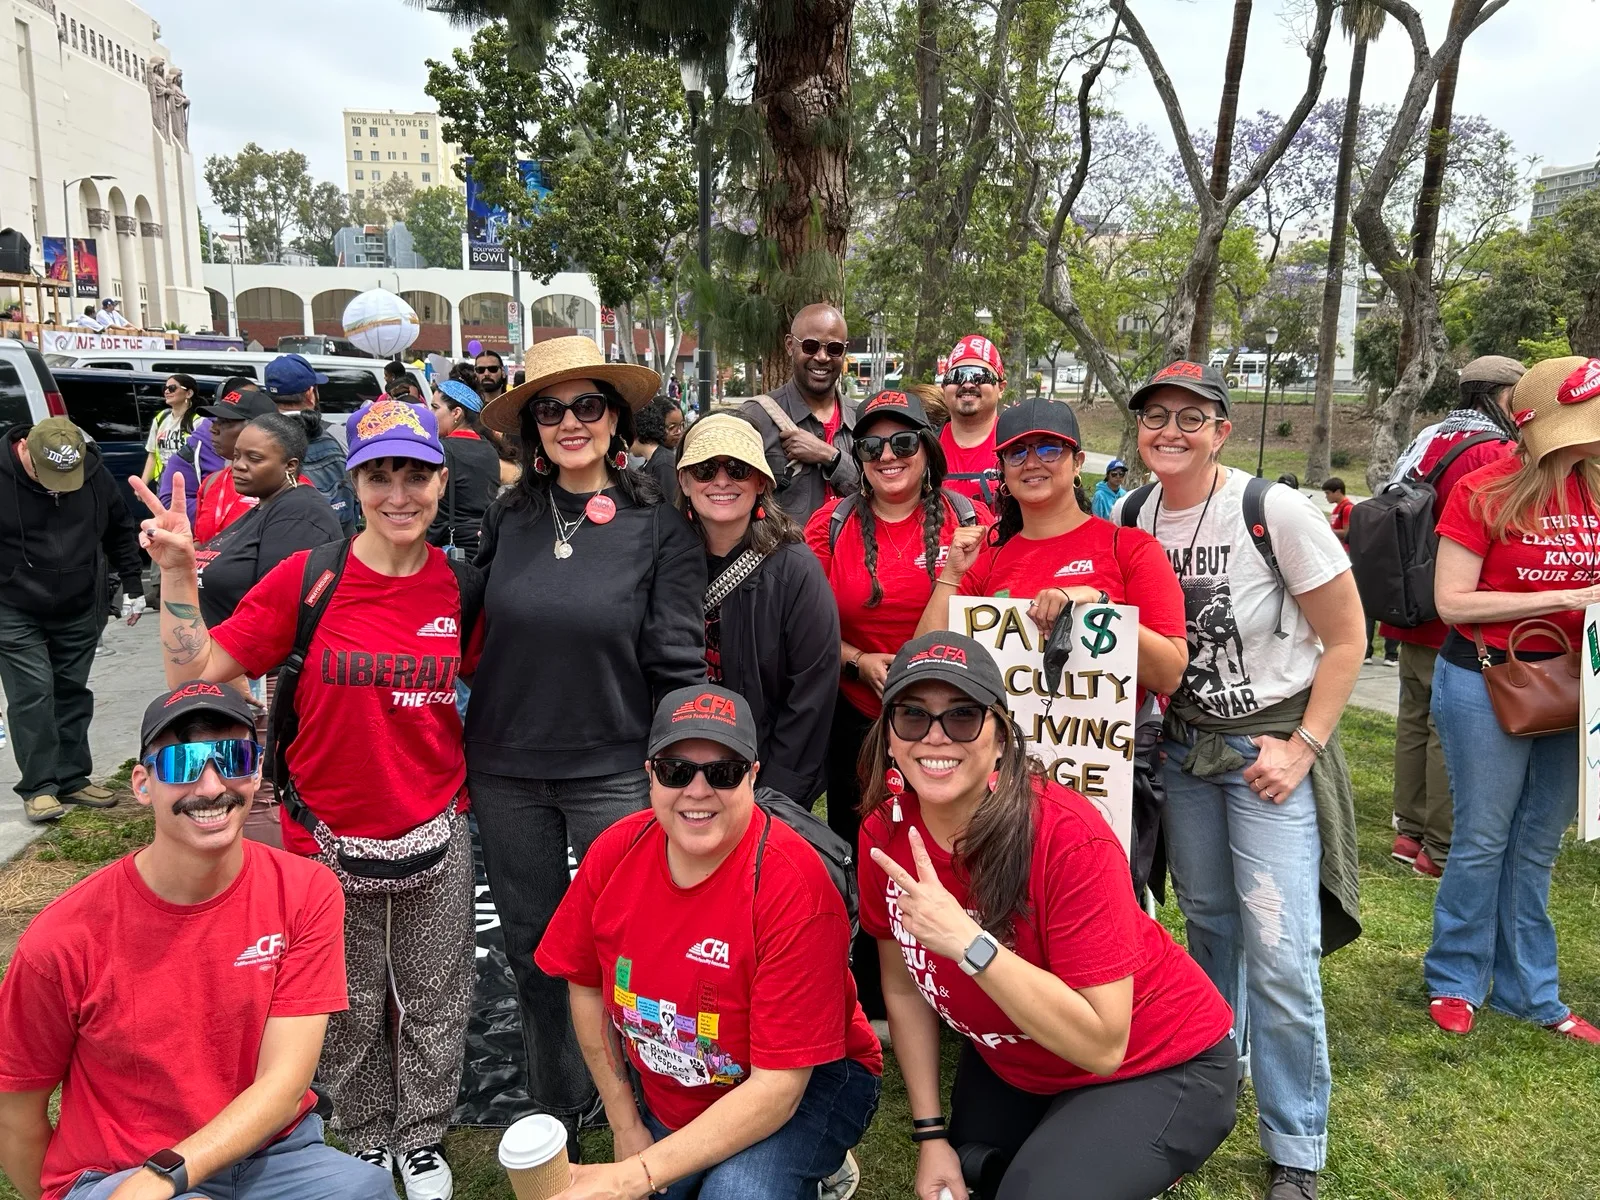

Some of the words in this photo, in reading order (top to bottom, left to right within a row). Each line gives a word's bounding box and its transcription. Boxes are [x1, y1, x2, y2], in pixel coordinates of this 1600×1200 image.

[351, 117, 367, 125] NOB
[372, 117, 390, 126] HILL
[394, 118, 429, 127] TOWERS
[473, 252, 505, 263] BOWL
[76, 336, 95, 349] WE
[100, 337, 121, 349] ARE
[123, 339, 142, 350] THE
[1167, 362, 1203, 377] CFA
[880, 391, 908, 404] CFA
[1539, 514, 1579, 530] THIS
[1582, 515, 1598, 529] IS
[1522, 532, 1576, 547] CLASS
[1068, 560, 1094, 572] CFA
[1196, 545, 1230, 576] BUT
[1544, 551, 1600, 566] KNOW
[1516, 567, 1568, 582] YOUR
[434, 617, 457, 633] CFA
[1080, 607, 1122, 659] $
[928, 644, 967, 664] CFA
[183, 683, 222, 694] CFA
[1004, 664, 1132, 704] CULTY
[392, 691, 428, 708] THE
[426, 692, 458, 705] CSU
[694, 693, 736, 720] CFA
[1208, 688, 1259, 718] WAR
[672, 714, 692, 722] California
[891, 777, 902, 786] CFA
[1048, 757, 1110, 797] GE
[700, 938, 729, 962] CFA
[650, 1042, 682, 1063] Rights
[650, 1049, 690, 1073] Respect
